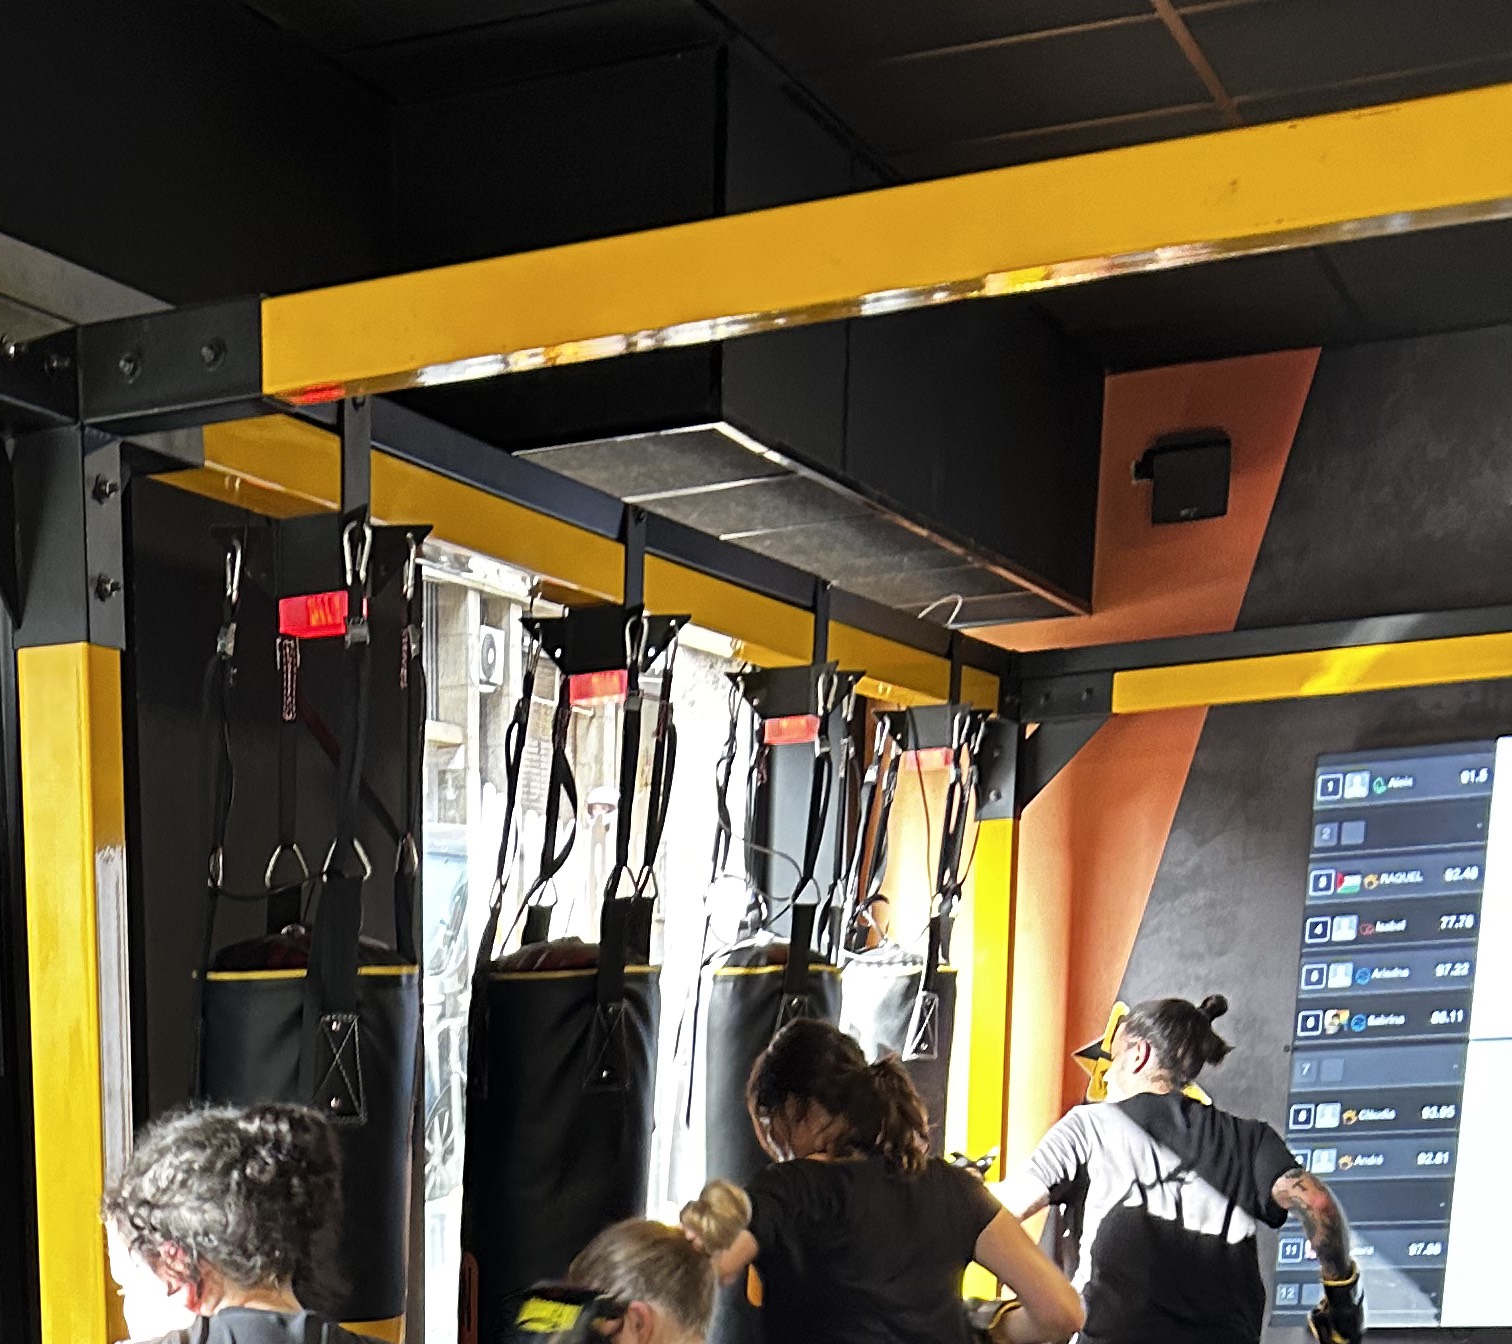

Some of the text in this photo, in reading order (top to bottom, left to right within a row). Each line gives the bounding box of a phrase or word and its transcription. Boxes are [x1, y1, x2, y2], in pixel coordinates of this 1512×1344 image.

[1380, 870, 1424, 885] RAQUEL
[1301, 1062, 1311, 1076] 7
[1280, 1287, 1296, 1299] 12
